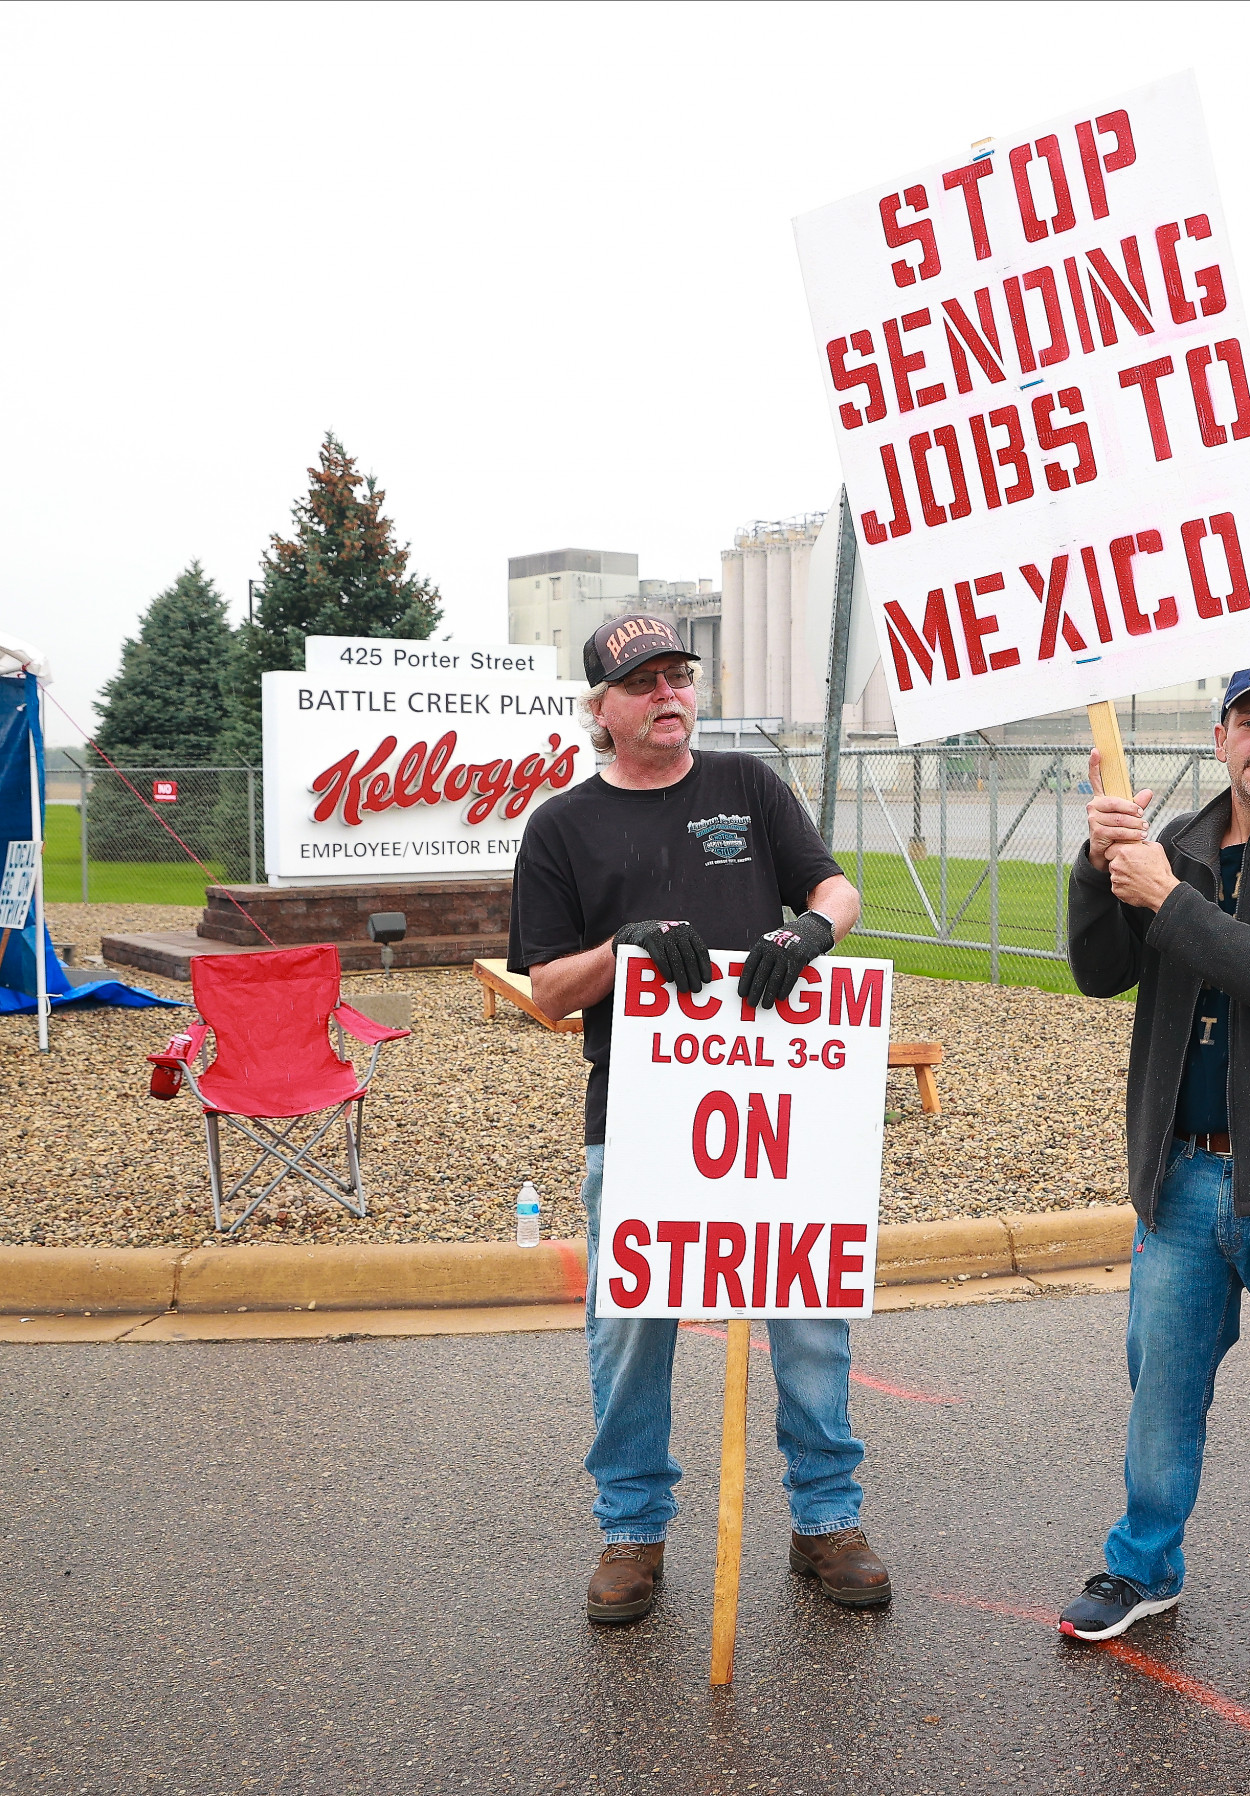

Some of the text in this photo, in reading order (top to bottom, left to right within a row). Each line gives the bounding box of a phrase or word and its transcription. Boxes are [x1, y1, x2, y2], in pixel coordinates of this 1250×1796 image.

[880, 109, 1137, 288] STOP
[826, 214, 1228, 430] SENDING
[861, 386, 1098, 545] JOBS
[340, 647, 535, 671] 425 Porter Street
[606, 618, 674, 660] HARLEY
[298, 689, 577, 716] BATTLE CREEK PLANT
[157, 783, 173, 795] NO
[313, 731, 580, 826] Kellogg's
[301, 839, 521, 859] EMPLOYEE/VISITOR ENT
[651, 1032, 846, 1070] LOCAL 3-G
[692, 1090, 792, 1180] ON
[609, 1219, 868, 1308] STRIKE
